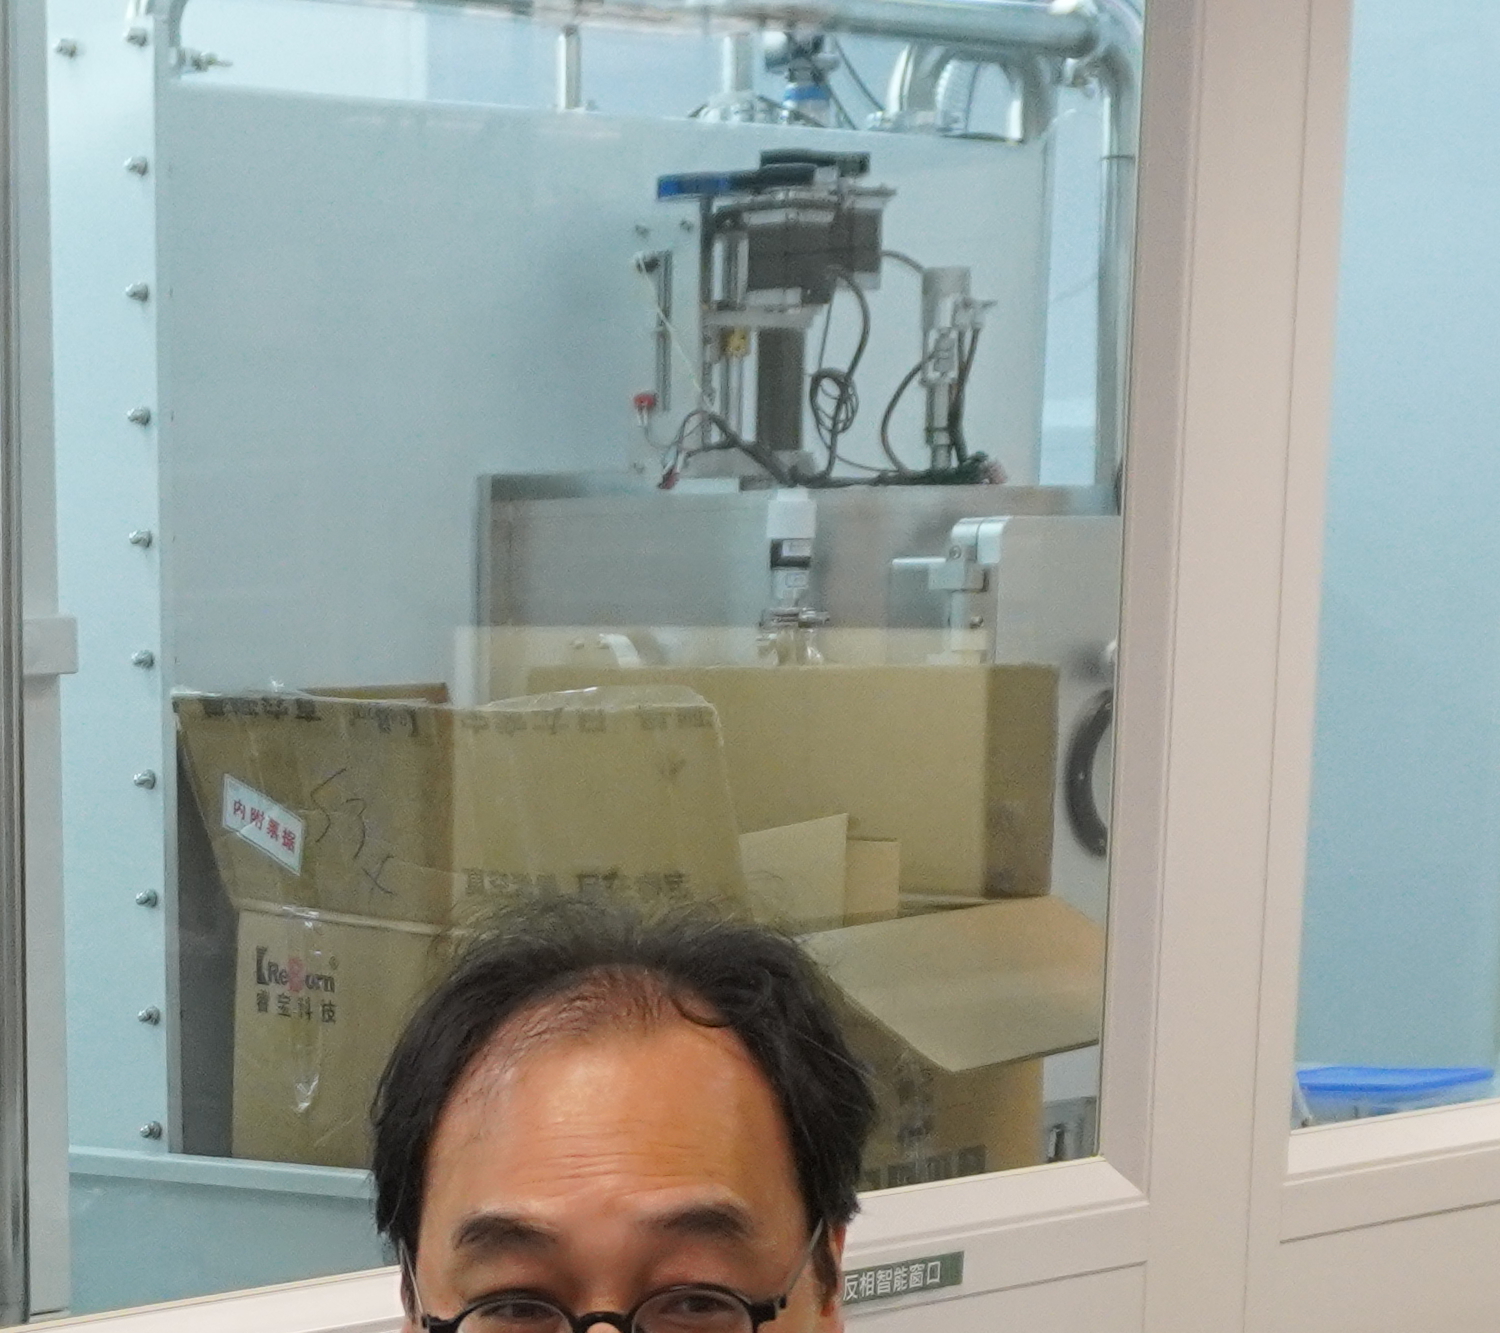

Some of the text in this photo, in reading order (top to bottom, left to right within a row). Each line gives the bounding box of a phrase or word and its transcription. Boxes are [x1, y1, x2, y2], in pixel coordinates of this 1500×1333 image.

[232, 799, 297, 853] 内附票据
[843, 1261, 941, 1300] 反相智能窗口
